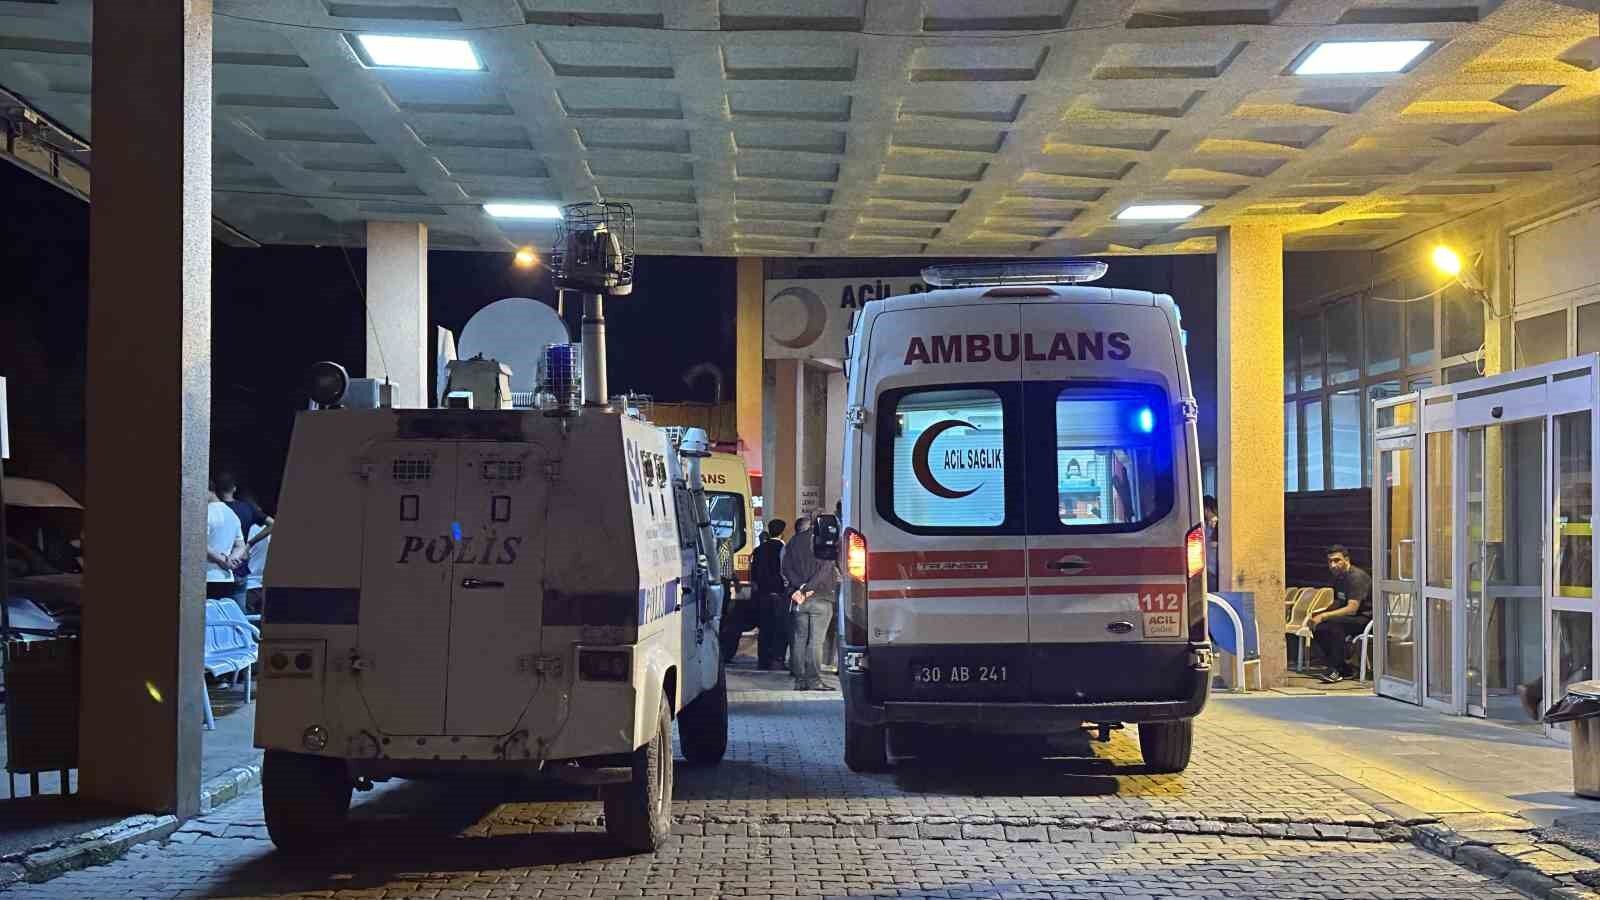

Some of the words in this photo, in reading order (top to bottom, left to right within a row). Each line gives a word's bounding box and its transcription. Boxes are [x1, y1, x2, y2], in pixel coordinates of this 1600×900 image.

[904, 331, 1132, 366] AMBULANS
[1142, 593, 1179, 611] 112
[922, 666, 941, 682] 30
[951, 666, 970, 681] AB
[979, 666, 1007, 681] 241
